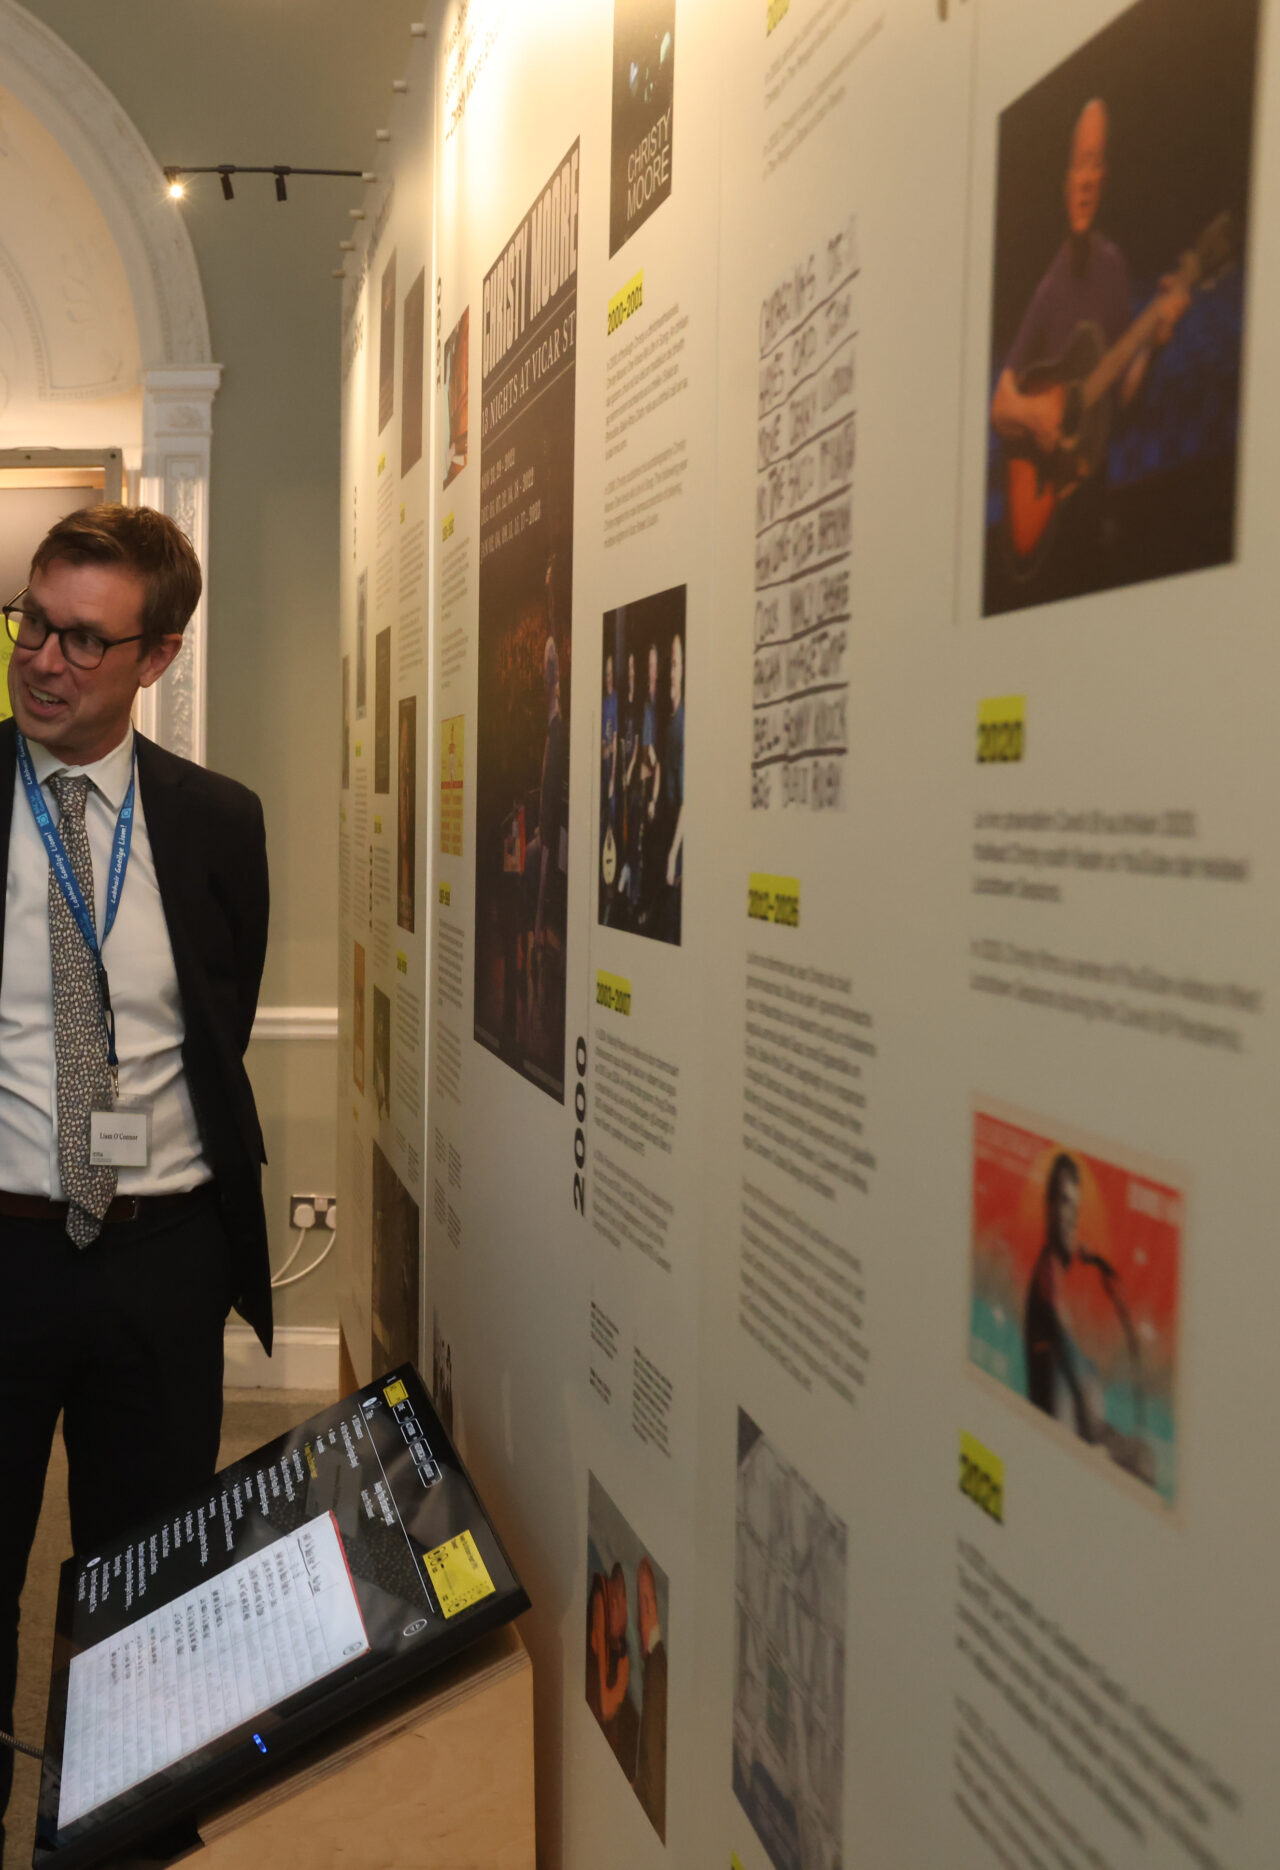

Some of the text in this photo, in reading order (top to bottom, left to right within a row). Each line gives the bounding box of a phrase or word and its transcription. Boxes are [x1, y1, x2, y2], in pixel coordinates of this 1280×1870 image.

[626, 145, 670, 221] MOORE
[628, 109, 671, 184] CHRISTY
[483, 147, 578, 383] CHRISTY MOORE
[607, 284, 643, 336] 2000-2001
[490, 369, 518, 436] NIGHTS
[520, 357, 531, 400] AT
[532, 324, 560, 389] VICAR
[562, 308, 576, 357] ST
[44, 831, 80, 909] Labhair Gaeilge Liom!
[111, 824, 128, 904] Labhair Gaeilge Liom!
[573, 1036, 587, 1216] 2000
